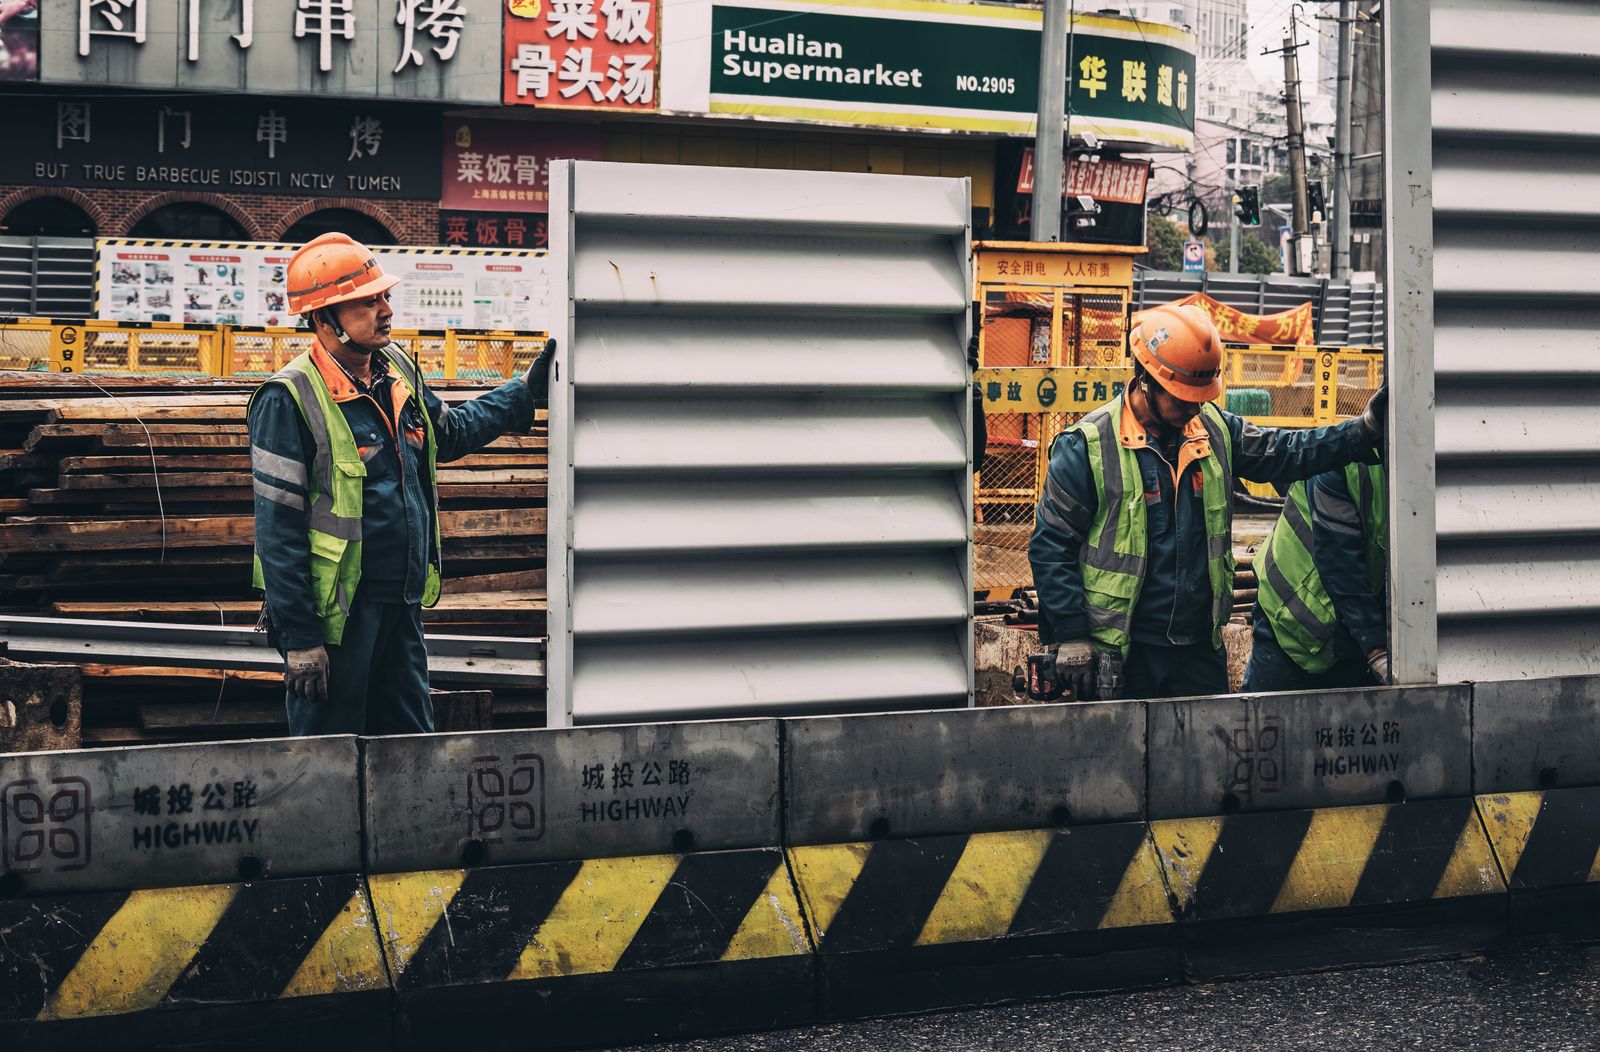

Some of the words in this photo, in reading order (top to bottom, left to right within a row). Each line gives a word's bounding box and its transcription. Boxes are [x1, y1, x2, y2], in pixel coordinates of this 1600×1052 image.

[544, 0, 654, 43] 菜饭
[723, 29, 843, 59] Hualian
[511, 43, 655, 104] 骨头汤
[722, 54, 923, 88] Supermarket
[956, 75, 1016, 94] NO.2905
[1079, 55, 1188, 111] 华联超市
[56, 101, 384, 161] 图门串烤
[35, 162, 69, 179] BUT
[83, 164, 126, 182] TRUE
[136, 166, 221, 185] BARBECUE
[347, 175, 401, 192] TUMEN
[997, 259, 1046, 276] 安全用电
[1063, 261, 1111, 278] 人人有责
[1320, 371, 1331, 419] 安全第一
[1313, 752, 1400, 777] HIGHWAY
[581, 796, 690, 823] HIGHWAY
[132, 819, 259, 850] HIGHWAY
